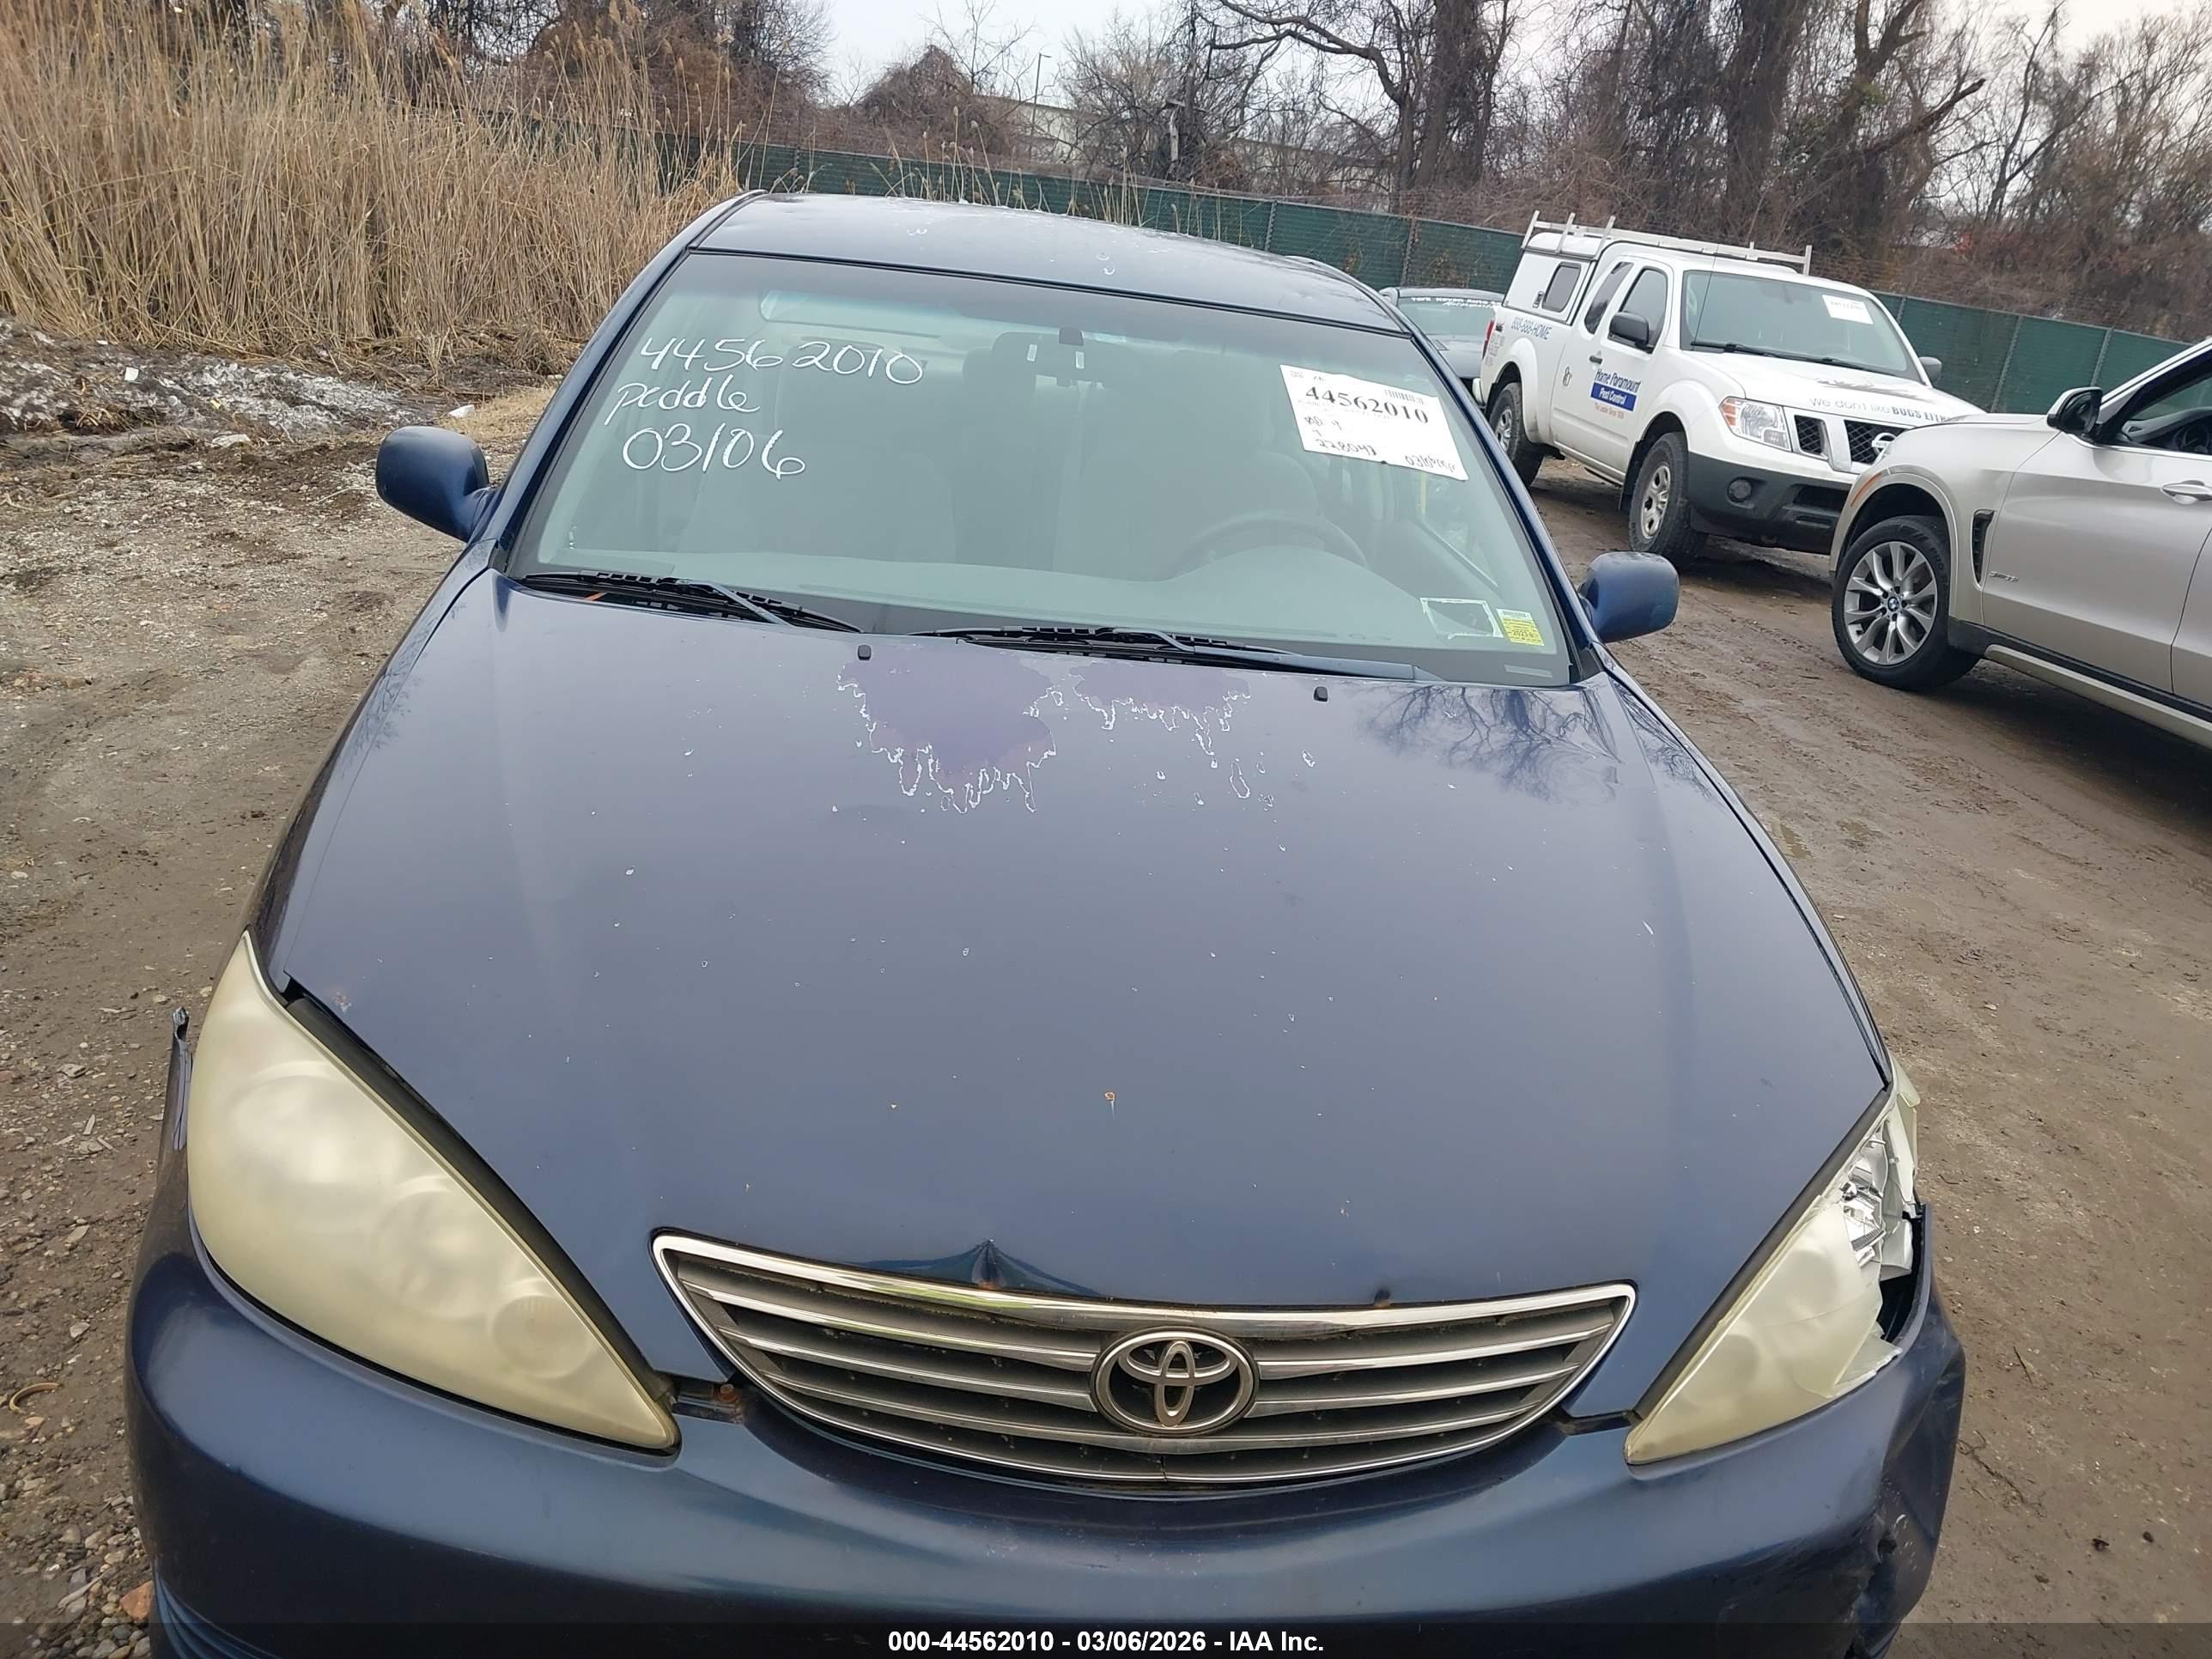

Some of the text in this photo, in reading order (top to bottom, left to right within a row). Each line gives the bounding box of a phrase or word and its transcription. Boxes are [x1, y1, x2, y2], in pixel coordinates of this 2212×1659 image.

[640, 337, 924, 385] 44562010
[1305, 386, 1430, 424] 44562010
[1891, 405, 1923, 420] BUGS
